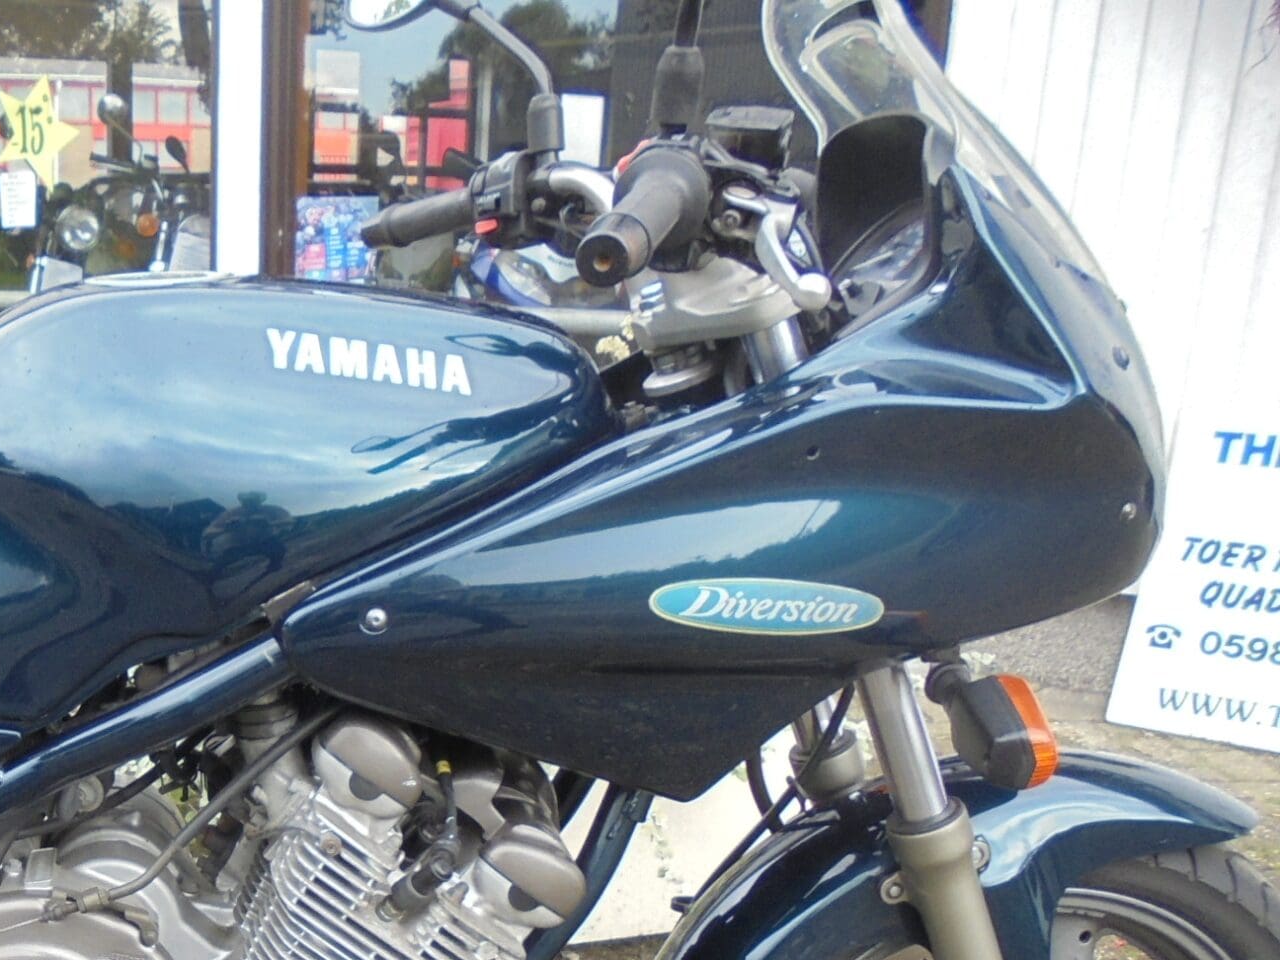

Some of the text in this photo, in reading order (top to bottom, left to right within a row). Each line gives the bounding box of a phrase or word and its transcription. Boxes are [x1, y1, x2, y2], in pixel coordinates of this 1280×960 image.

[266, 327, 472, 396] YAMAHA
[1214, 430, 1280, 468] TH
[1181, 536, 1267, 573] TOER
[678, 586, 859, 623] Diversion
